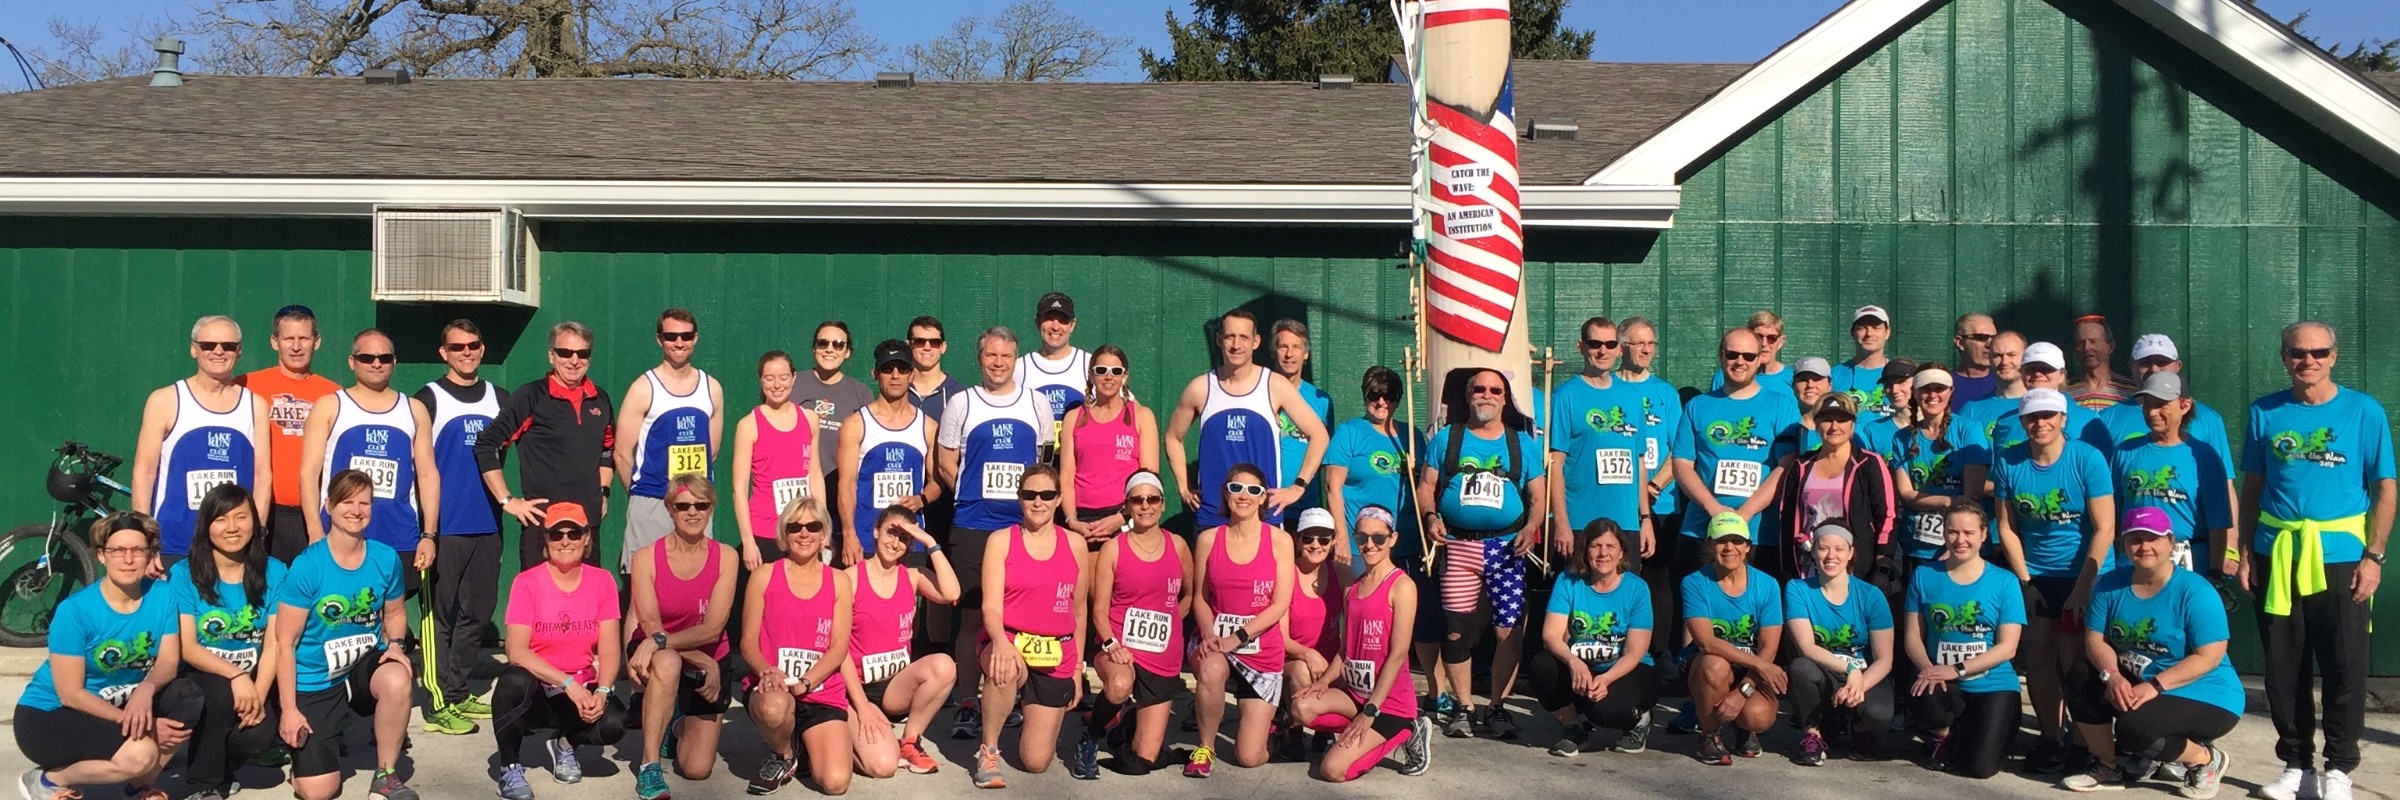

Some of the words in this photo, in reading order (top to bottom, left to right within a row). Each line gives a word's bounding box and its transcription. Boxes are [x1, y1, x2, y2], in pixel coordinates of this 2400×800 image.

[1451, 168, 1474, 178] CATCH
[1476, 168, 1490, 177] THE
[1448, 211, 1457, 220] AN
[1459, 208, 1494, 219] AMERICAN
[1448, 223, 1492, 235] INSTITUTION
[269, 407, 304, 420] AKE
[208, 431, 231, 440] LAKE
[366, 428, 389, 437] LAKE
[208, 438, 231, 449] RUN
[366, 434, 388, 444] RUN
[672, 446, 691, 454] LAKE
[354, 458, 376, 467] LAKE
[379, 460, 395, 470] RUN
[677, 454, 702, 471] 312
[1601, 458, 1632, 474] 1572
[1743, 462, 1759, 471] RUN
[1008, 465, 1022, 473] RUN
[191, 472, 215, 480] LAKE
[217, 471, 234, 479] RUN
[364, 468, 394, 488] 039
[987, 472, 1021, 489] 1038
[1720, 469, 1757, 488] 1539
[879, 481, 911, 498] 1607
[1464, 481, 1500, 498] 1040
[1130, 609, 1151, 619] LAKE
[1153, 613, 1169, 623] RUN
[1218, 615, 1240, 624] LAKE
[1127, 618, 1168, 641] 1608
[328, 638, 353, 650] LAKE
[356, 635, 374, 645] RUN
[1022, 640, 1052, 654] 281
[1941, 644, 1963, 652] LAKE
[1967, 644, 1984, 652] RUN
[215, 651, 234, 660] AKE
[237, 651, 254, 660] RUN
[782, 650, 805, 659] LAKE
[807, 652, 821, 661] RUN
[866, 655, 889, 665] LAKE
[890, 651, 906, 660] RUN
[1576, 647, 1614, 661] 1047
[232, 659, 253, 671] 72
[784, 659, 812, 678] 167
[1355, 662, 1371, 670] RUN
[1344, 667, 1371, 689] 1124
